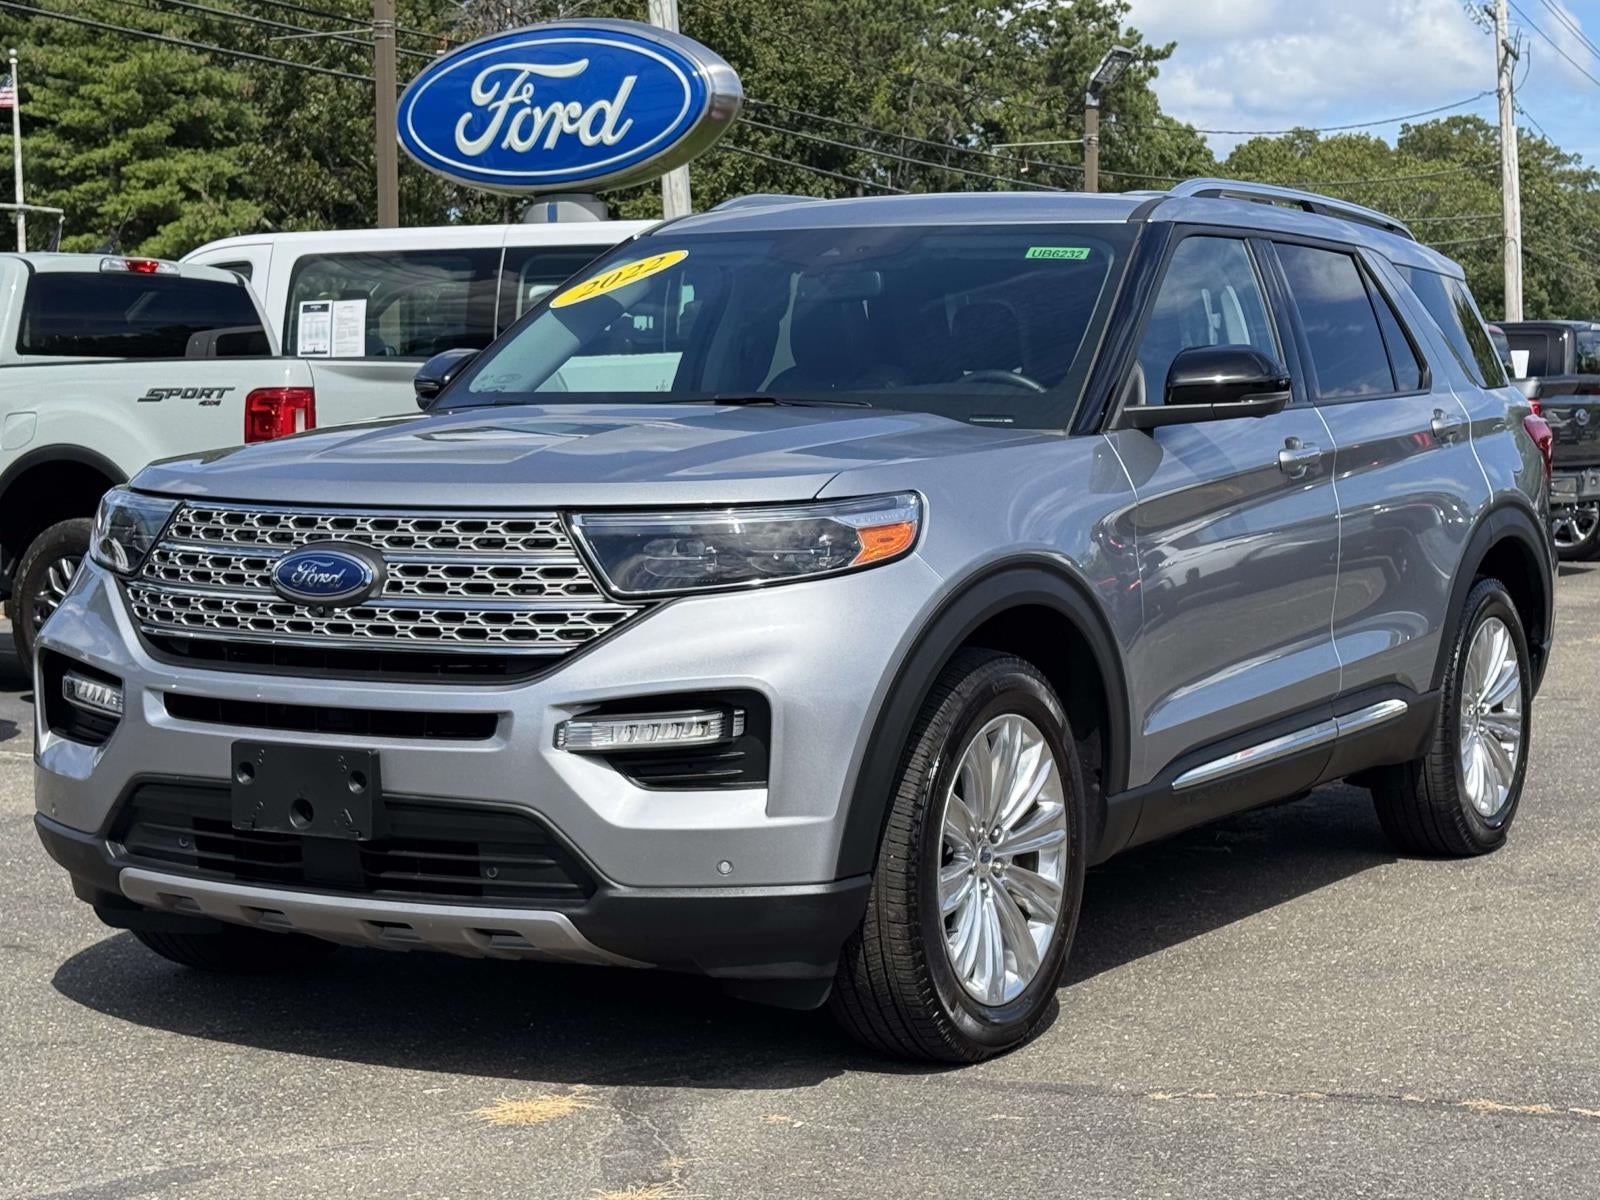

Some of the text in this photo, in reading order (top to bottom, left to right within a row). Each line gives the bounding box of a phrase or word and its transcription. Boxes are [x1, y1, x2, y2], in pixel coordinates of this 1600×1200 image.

[454, 58, 638, 157] Ford
[1031, 249, 1084, 259] UB6232
[574, 256, 667, 299] 2022
[137, 387, 236, 402] SPORT
[291, 560, 347, 587] Ford
